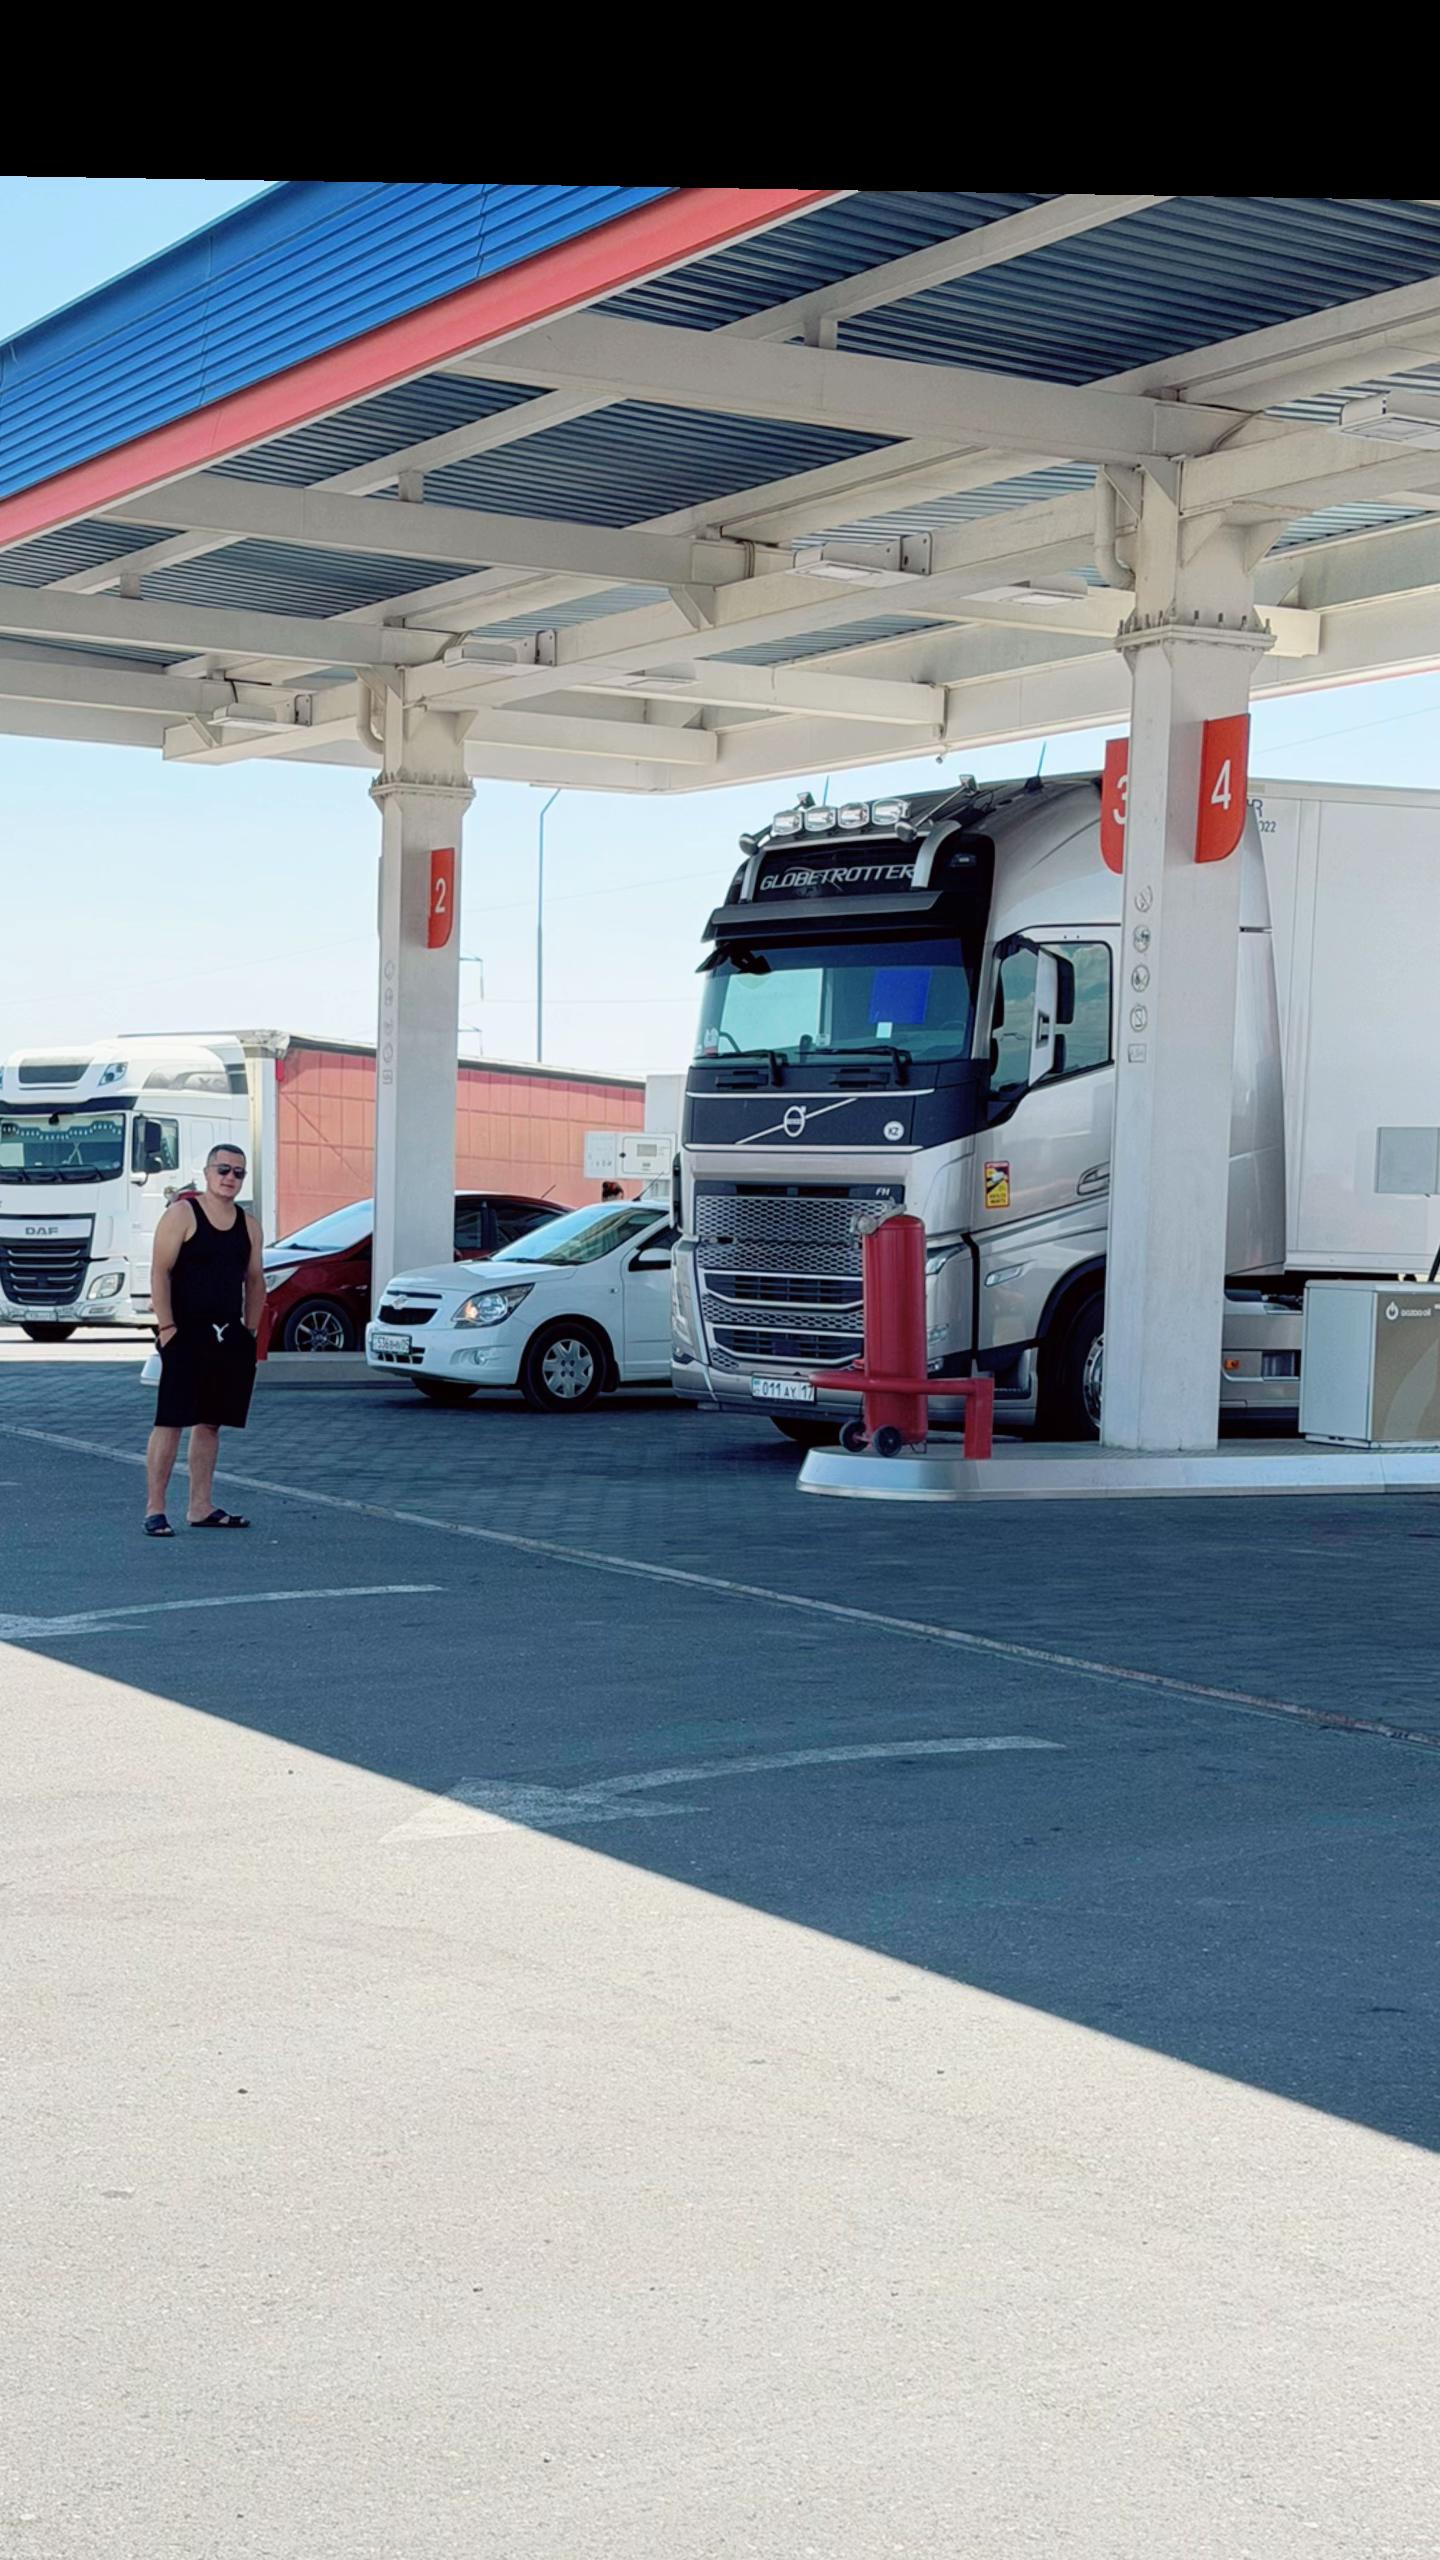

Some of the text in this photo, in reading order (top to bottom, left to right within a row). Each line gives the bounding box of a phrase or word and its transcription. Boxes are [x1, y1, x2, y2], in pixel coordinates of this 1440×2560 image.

[1210, 759, 1231, 810] 4
[760, 864, 916, 890] GLOBETROTTER
[435, 878, 446, 913] 2
[887, 1126, 900, 1137] KZ
[875, 1187, 890, 1196] FH
[25, 1226, 59, 1235] DAF
[762, 1381, 781, 1397] 011
